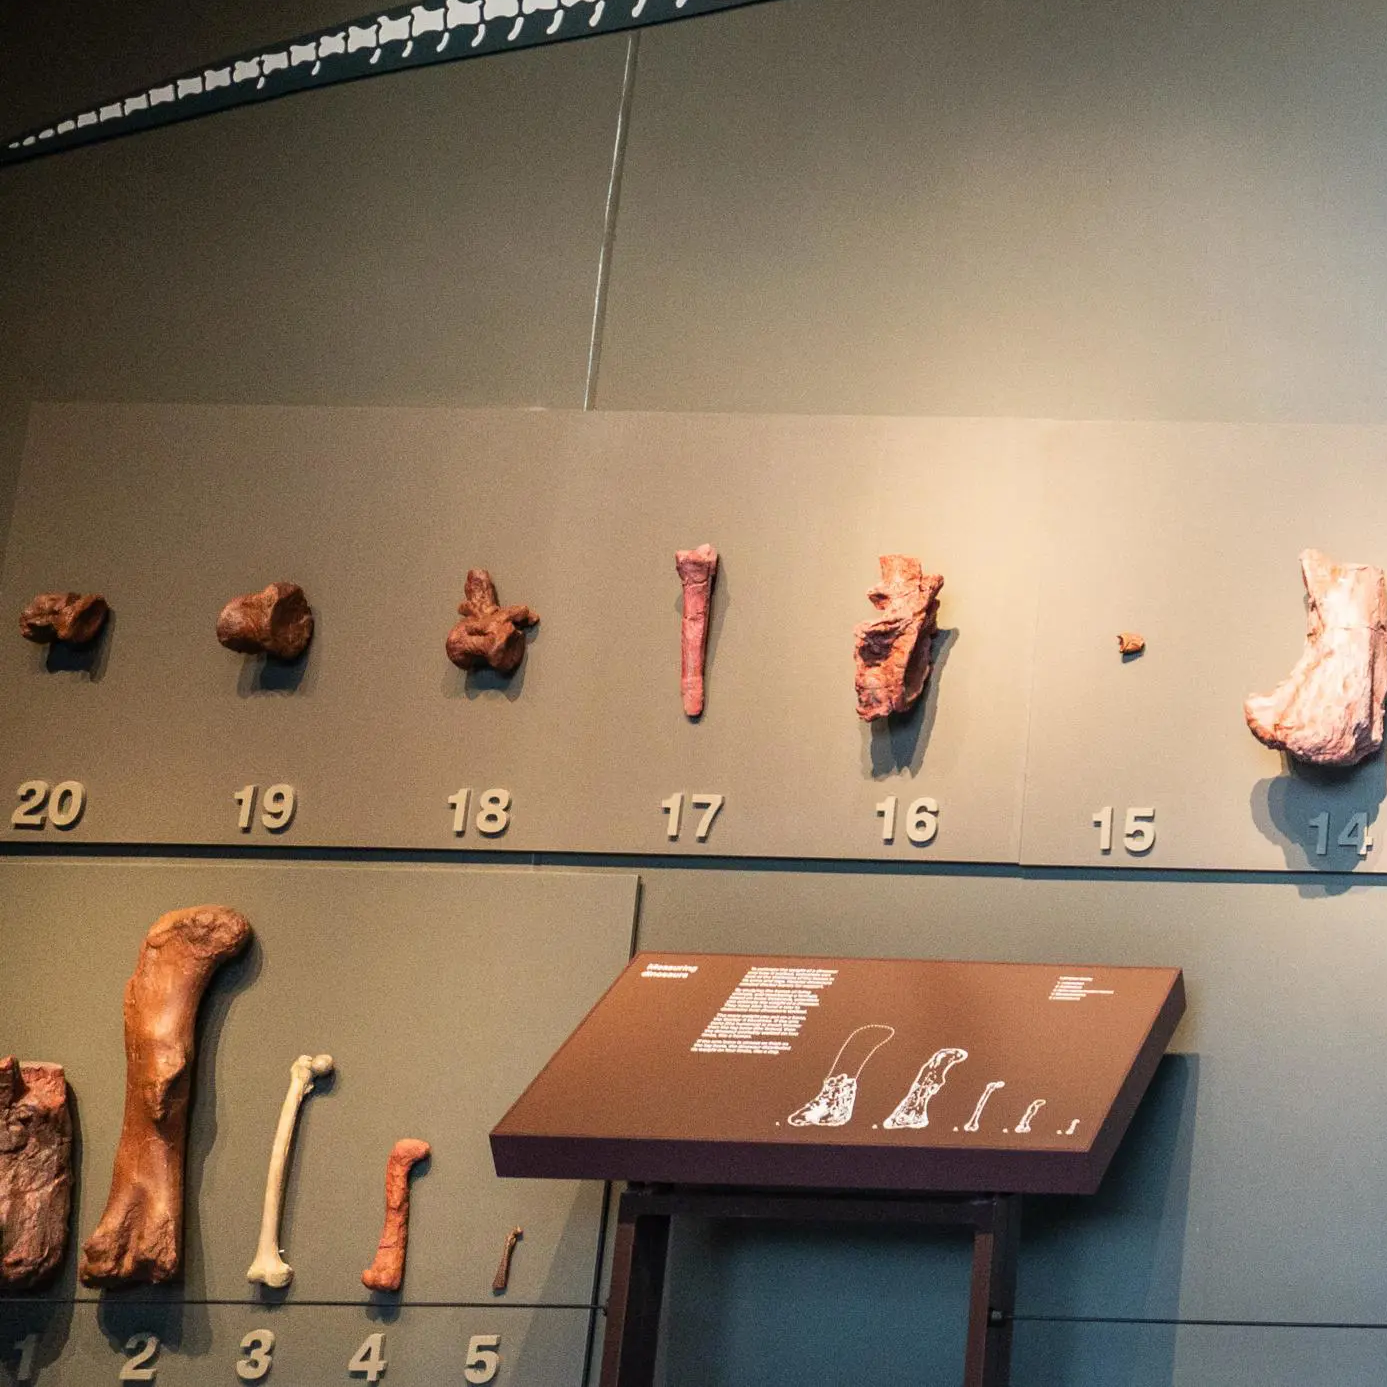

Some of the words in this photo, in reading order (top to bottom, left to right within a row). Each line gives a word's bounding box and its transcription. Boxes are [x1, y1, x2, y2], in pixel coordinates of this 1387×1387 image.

[13, 780, 85, 828] 20
[233, 784, 297, 830] 19
[447, 788, 511, 834] 18
[660, 792, 725, 838] 17
[876, 796, 938, 843] 16
[1092, 806, 1155, 852] 15
[1308, 811, 1373, 856] 14
[13, 1335, 39, 1381] 1
[118, 1331, 162, 1381] 2
[235, 1328, 275, 1380] 3
[347, 1333, 389, 1382] 4
[463, 1334, 502, 1384] 5
